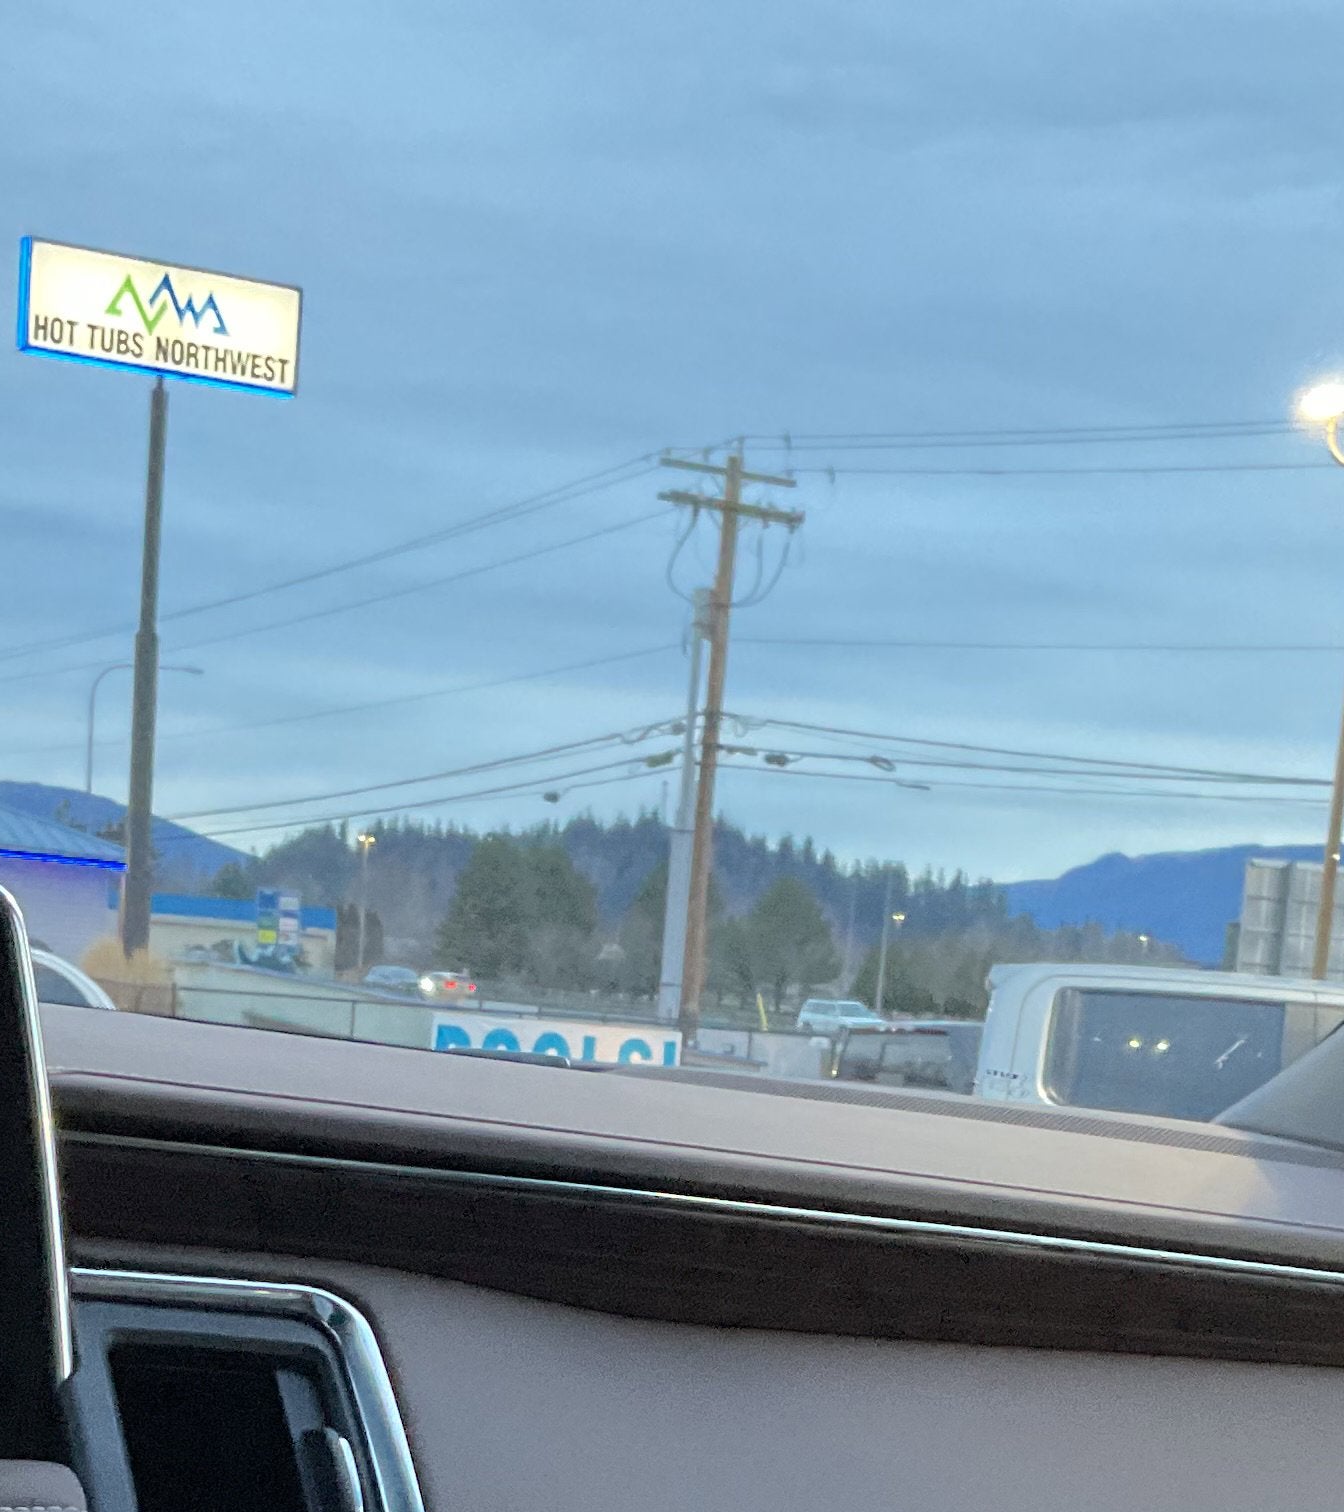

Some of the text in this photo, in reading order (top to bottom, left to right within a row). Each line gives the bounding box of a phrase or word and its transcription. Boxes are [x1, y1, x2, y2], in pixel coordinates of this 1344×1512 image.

[33, 315, 290, 384] HOT TUBS NORTHWEST
